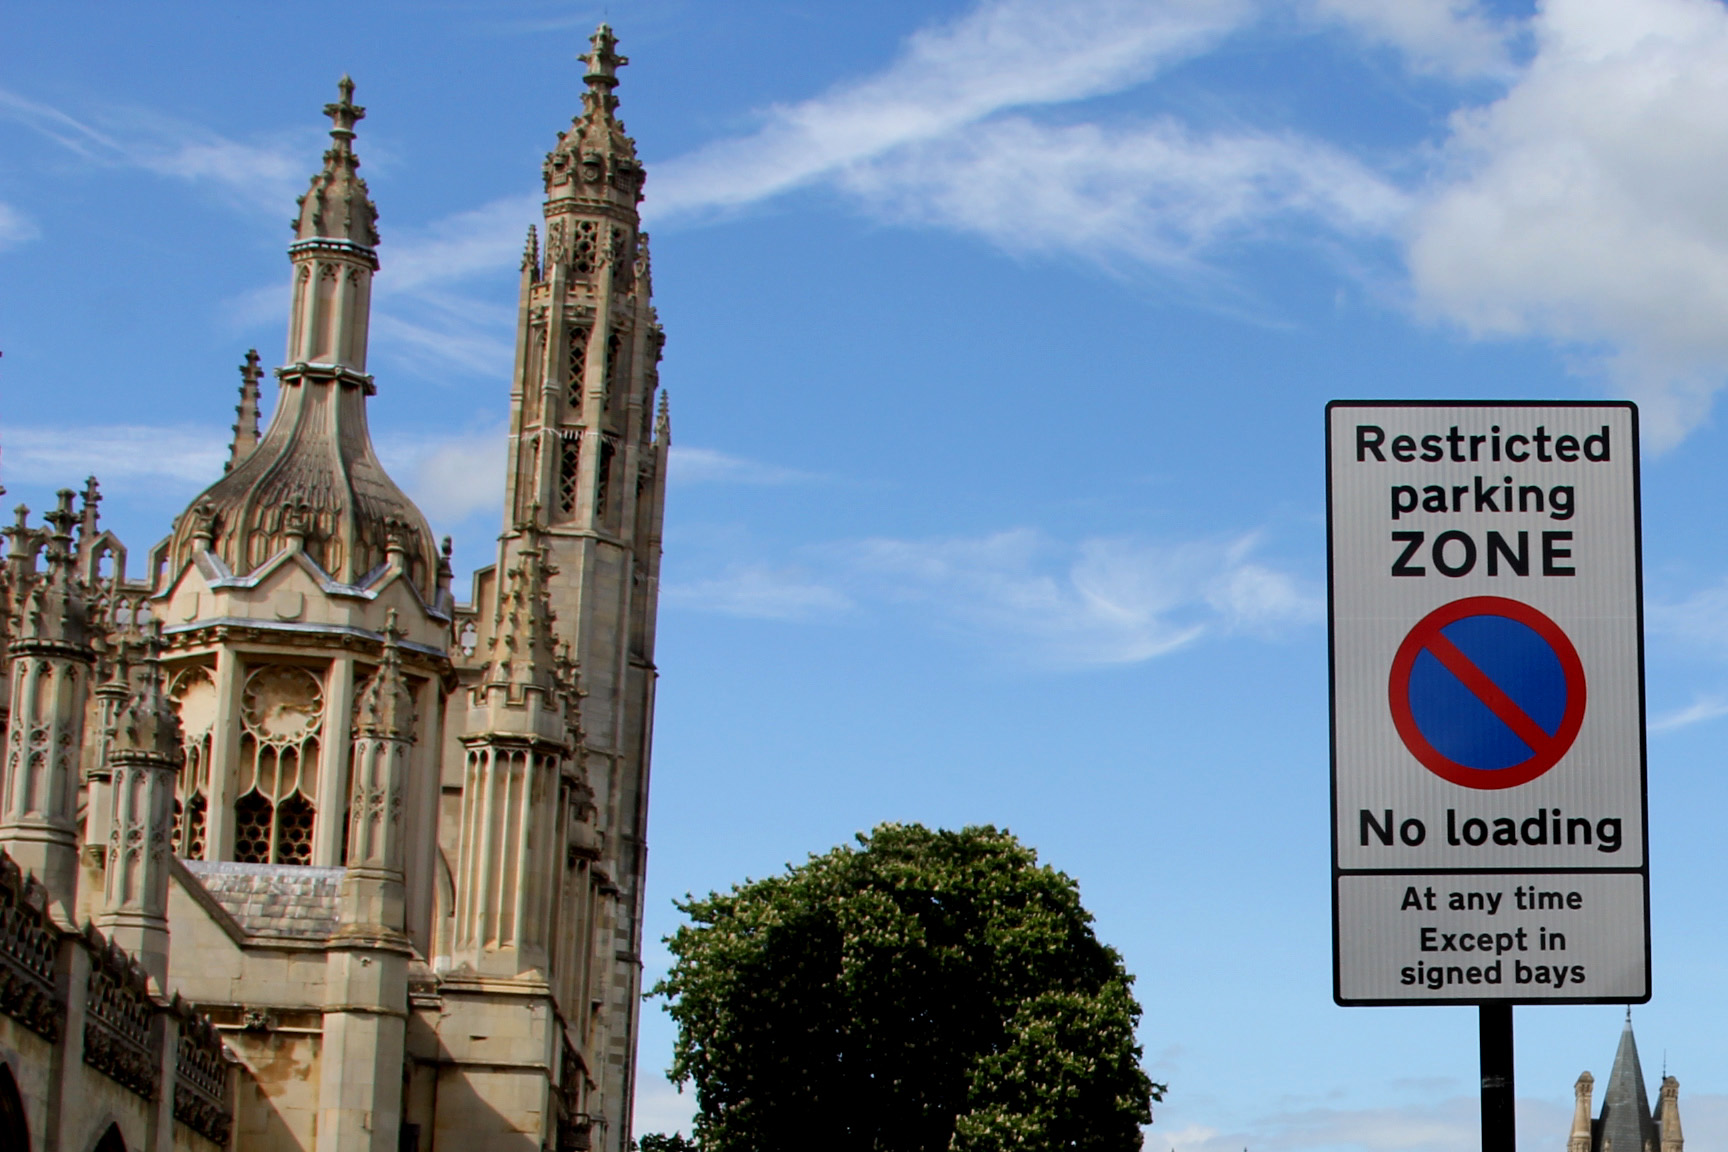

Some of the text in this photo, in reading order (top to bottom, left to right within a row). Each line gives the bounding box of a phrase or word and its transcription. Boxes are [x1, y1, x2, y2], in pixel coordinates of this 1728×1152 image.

[1356, 425, 1611, 462] Restricted
[1391, 475, 1575, 520] parking
[1391, 530, 1576, 577] ZONE
[1359, 808, 1623, 853] No loading
[1401, 886, 1583, 915] At any time
[1420, 927, 1566, 956] Except in
[1400, 959, 1586, 990] signed bays
